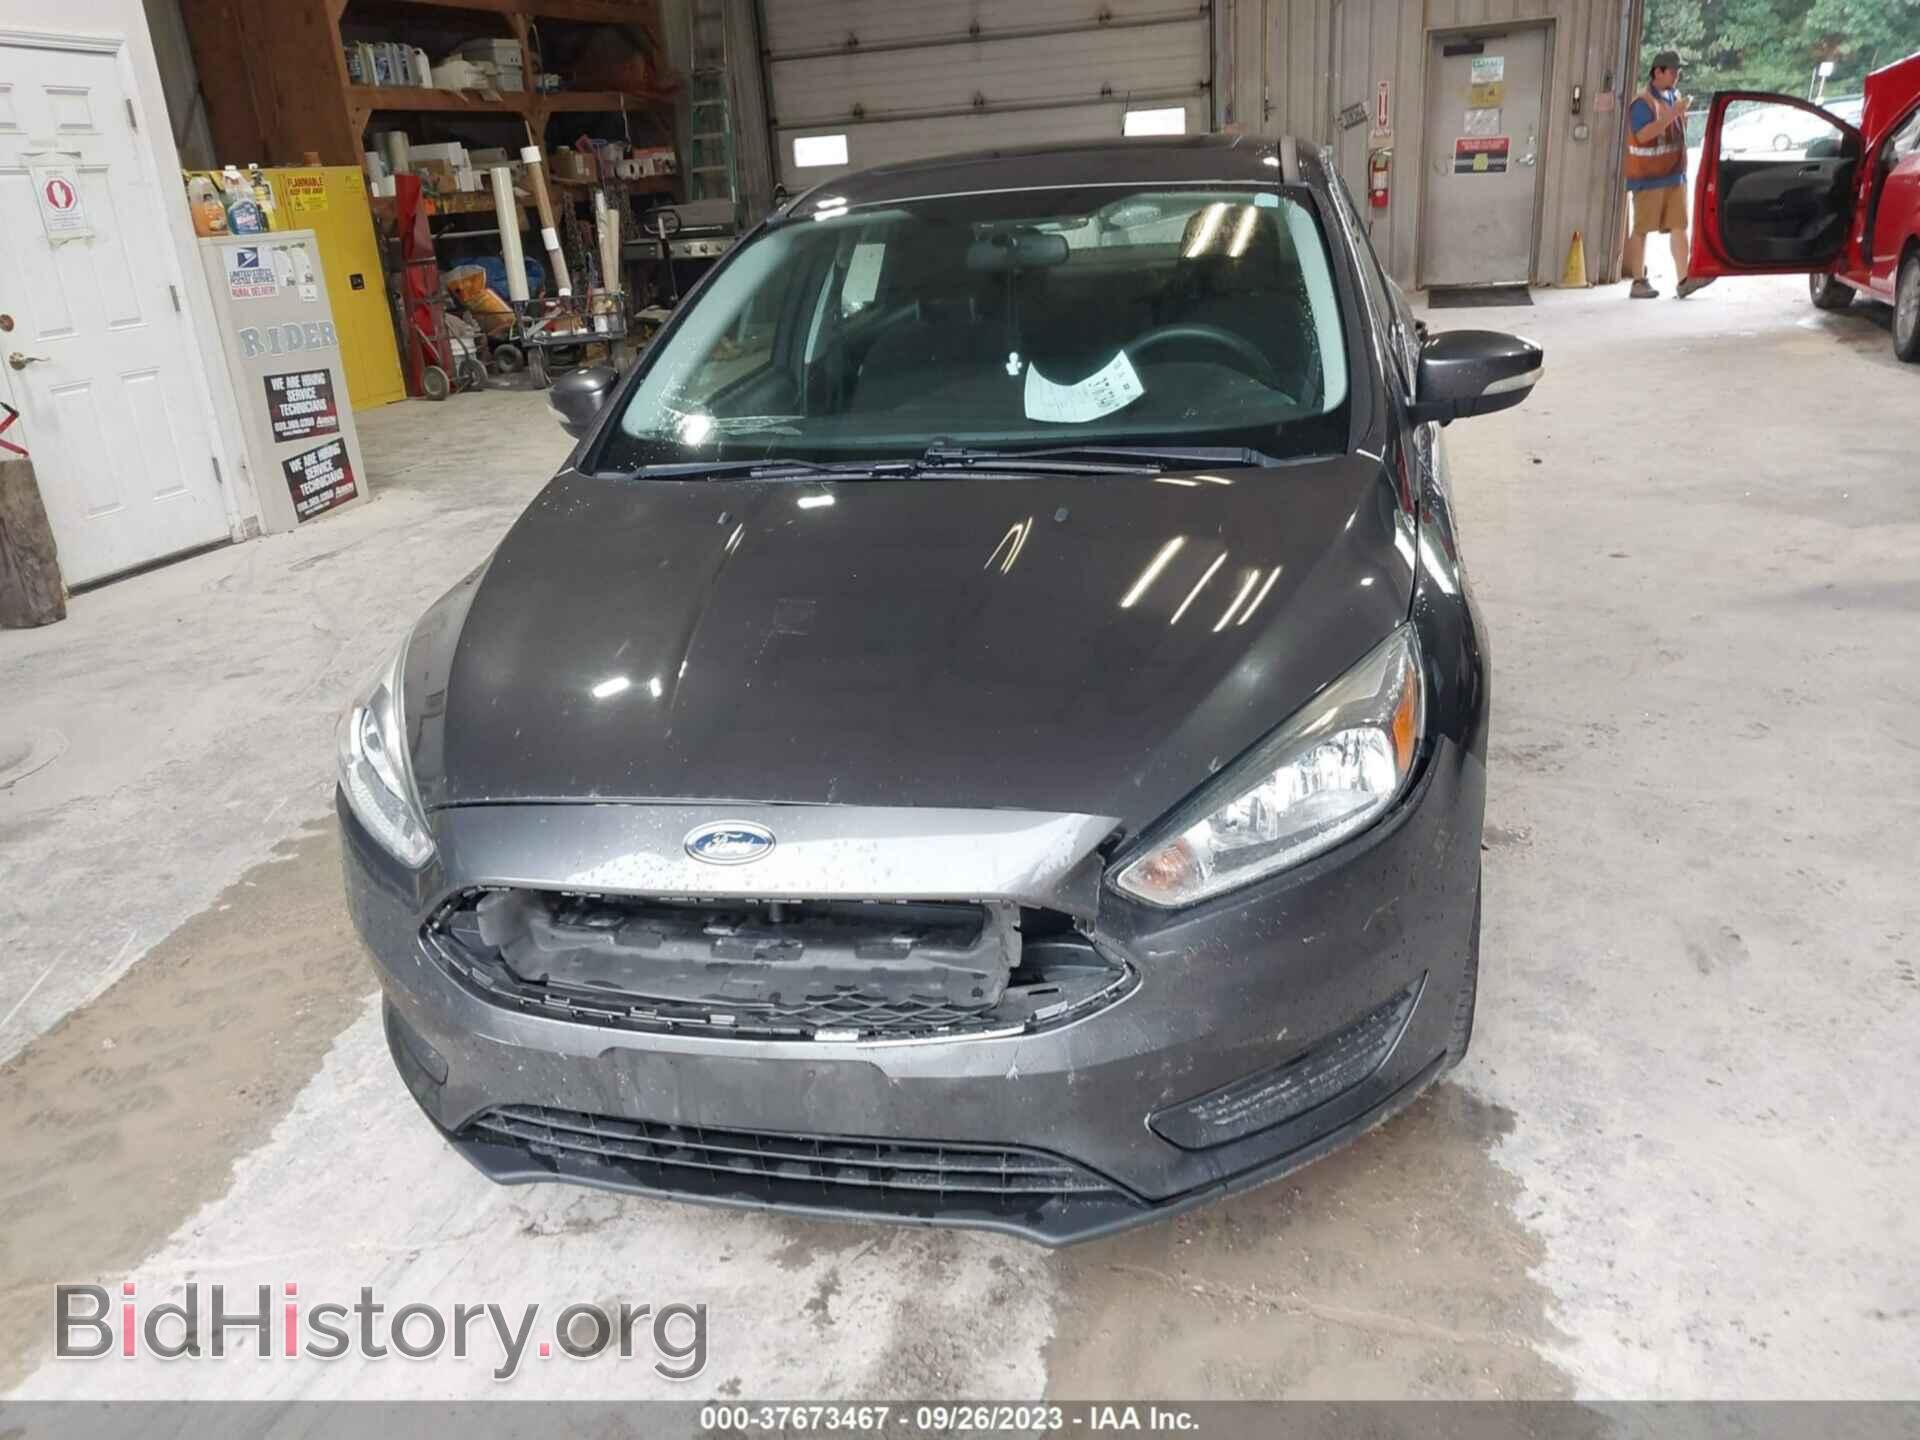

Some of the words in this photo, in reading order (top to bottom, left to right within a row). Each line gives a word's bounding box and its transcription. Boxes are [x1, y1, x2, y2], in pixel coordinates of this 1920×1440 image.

[238, 320, 337, 358] RIDER
[271, 378, 285, 391] WE
[286, 375, 301, 389] ARE
[286, 386, 317, 402] SERVICE
[279, 398, 328, 417] TECHNICIANS
[288, 458, 303, 473] WE
[303, 451, 319, 468] ARE
[304, 459, 334, 481] SERVICE
[299, 467, 345, 496] TECHNICIANS
